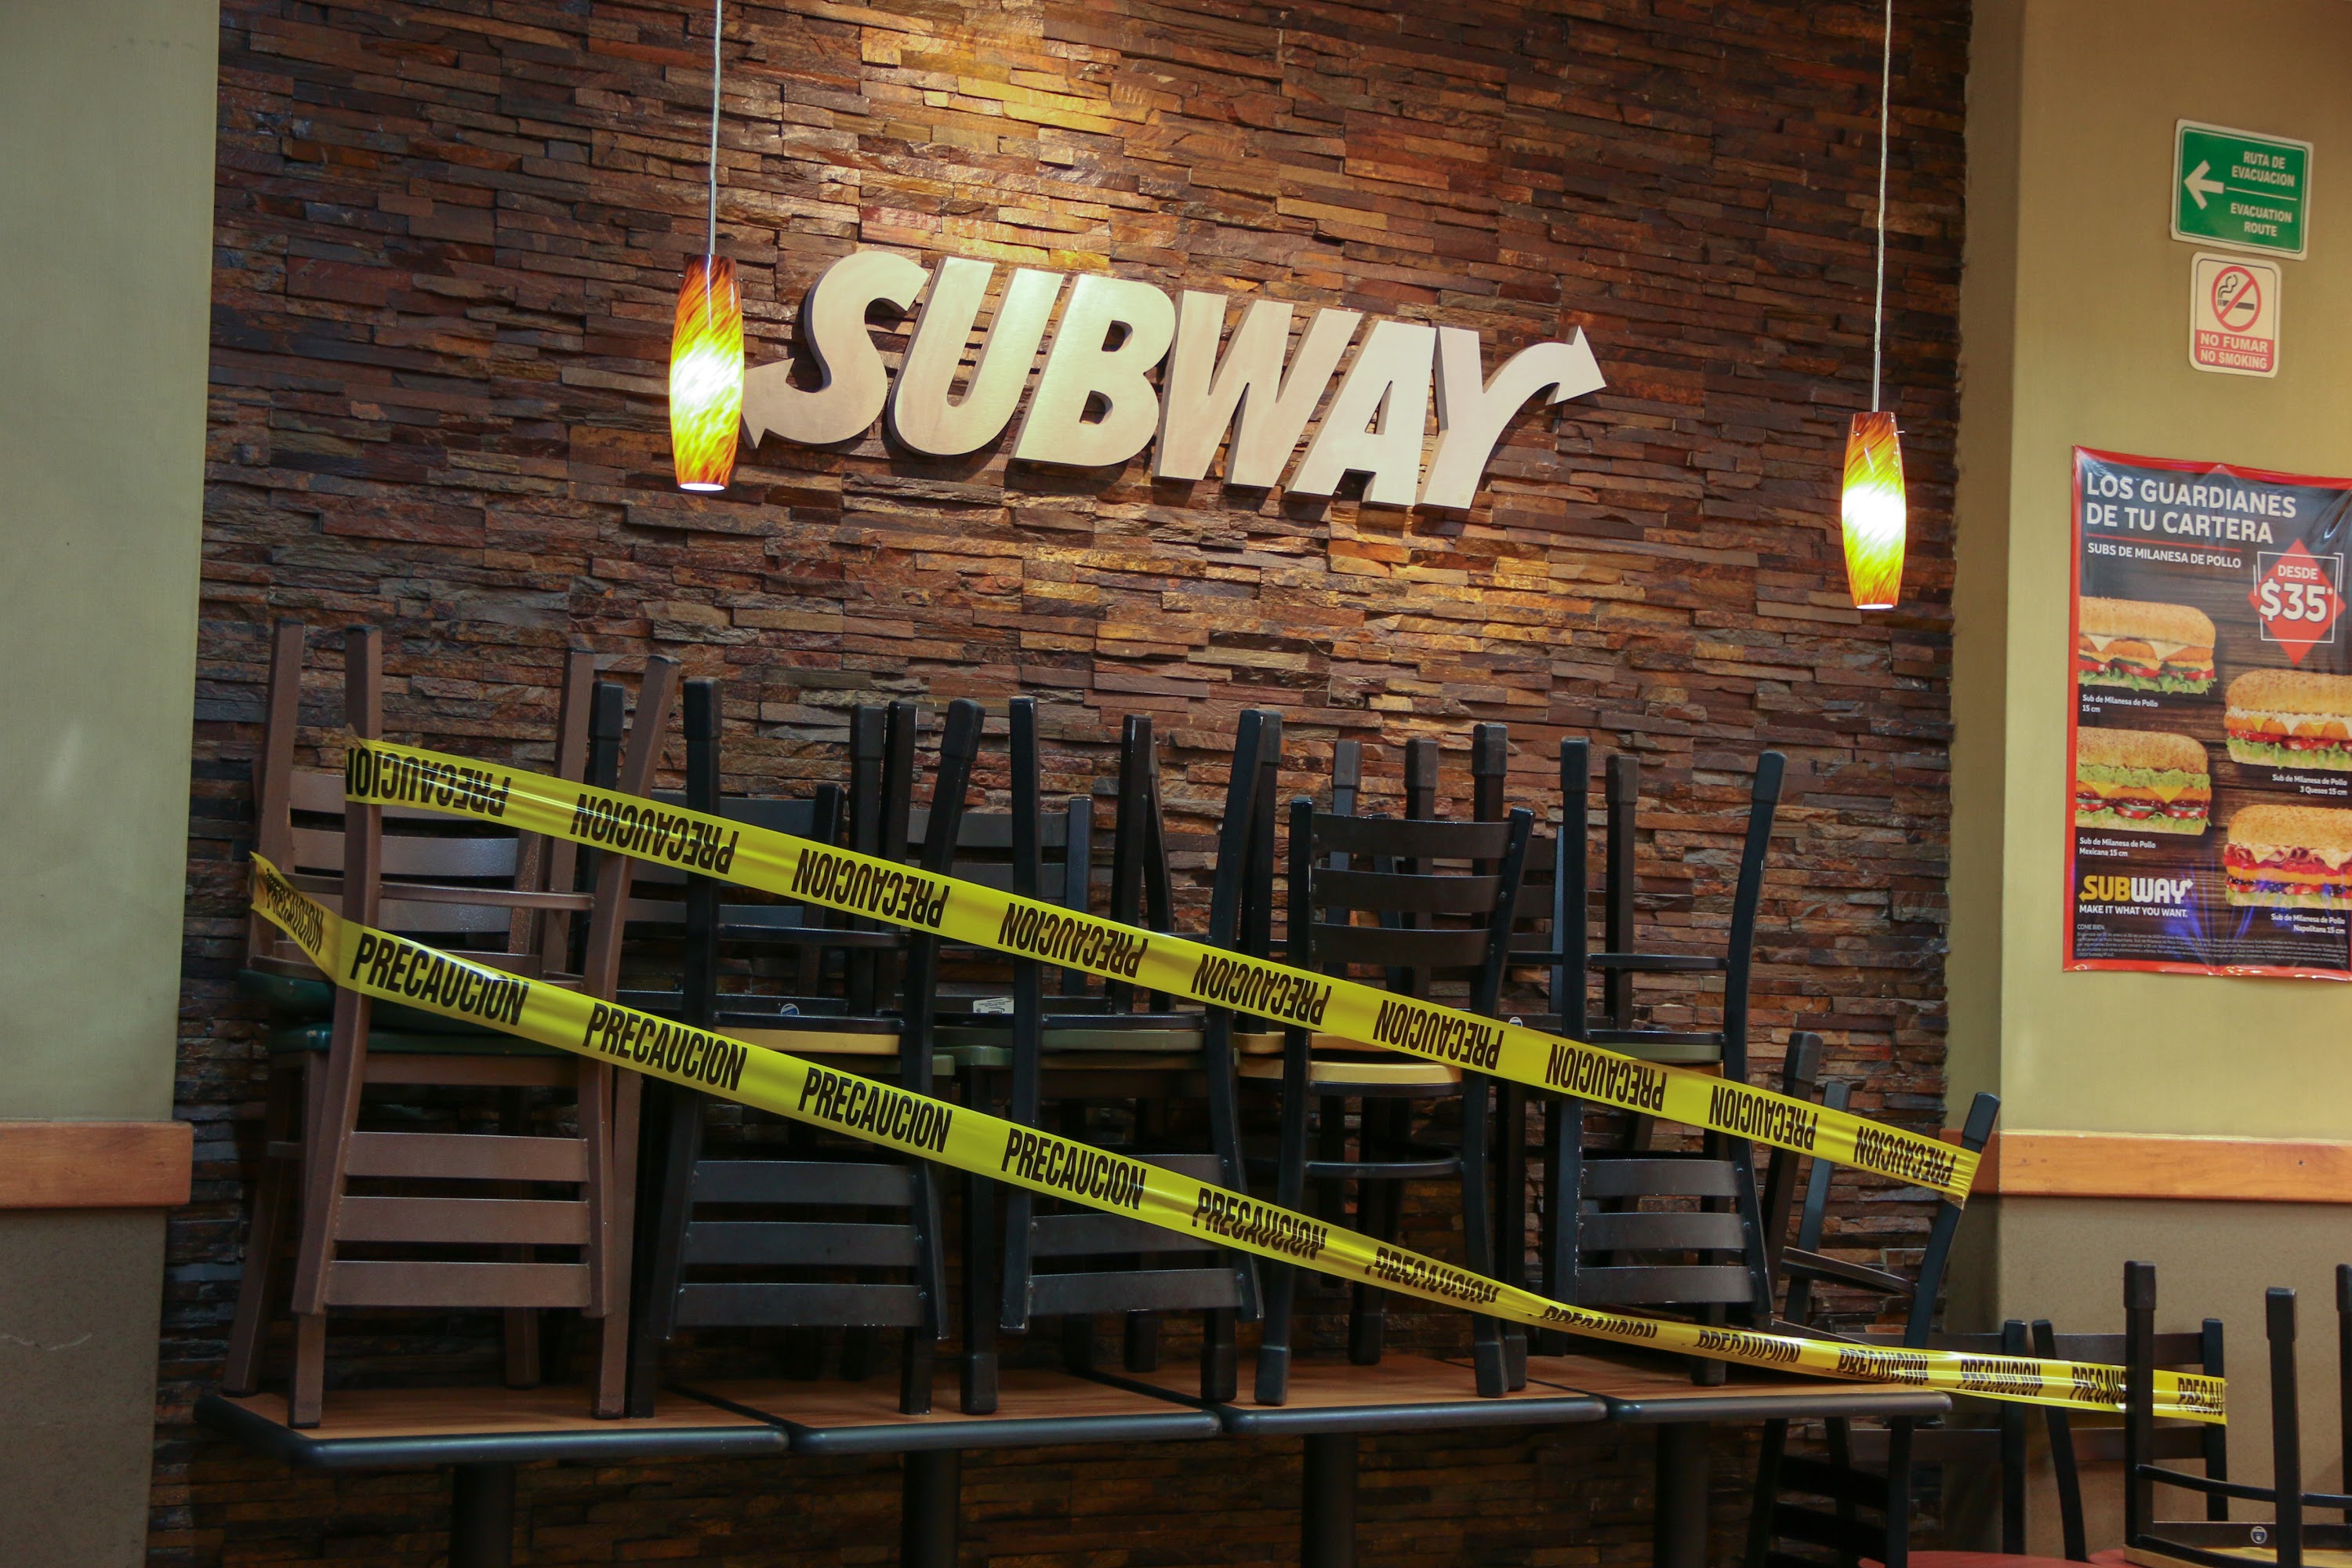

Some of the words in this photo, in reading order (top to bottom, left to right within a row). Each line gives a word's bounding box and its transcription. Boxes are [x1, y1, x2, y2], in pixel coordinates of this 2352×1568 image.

[2243, 151, 2269, 166] RUTA
[2272, 155, 2285, 169] DE
[2232, 165, 2295, 187] EVACUACION
[2230, 203, 2292, 223] EVACUATION
[2245, 221, 2278, 236] ROUTE
[2201, 333, 2219, 347] NO
[2223, 336, 2268, 353] FUMAR
[2201, 349, 2216, 362] NO
[2219, 351, 2267, 369] SMOKING
[741, 252, 1606, 509] SUBWAY
[2087, 472, 2134, 500] LOS
[2140, 480, 2296, 518] GUARDIANES
[2086, 503, 2118, 527] DE
[2124, 507, 2156, 532] TU
[2162, 512, 2274, 544] CARTERA
[2088, 543, 2116, 557] SUBS
[2118, 546, 2132, 558] DE
[2135, 548, 2188, 564] MILANESA
[2190, 554, 2205, 565] DE
[2206, 555, 2241, 568] POLLO
[2278, 564, 2318, 580] DESDE
[2082, 694, 2094, 702] Sub
[2104, 696, 2131, 706] Milanesa
[2142, 699, 2158, 707] Pollo
[2272, 774, 2283, 782] Sub
[2294, 775, 2321, 785] Milanesa
[2305, 786, 2327, 795] Quesos
[2079, 848, 2107, 856] Mexicana
[2102, 839, 2129, 848] Milanesa
[2079, 875, 2194, 904] SUBWAY
[2079, 905, 2104, 914] MAKE
[2106, 906, 2113, 914] IT
[2114, 906, 2140, 916] WHAT
[2142, 908, 2159, 916] YOU
[2161, 909, 2188, 918] WANT.
[2270, 913, 2282, 921] Sub
[2293, 924, 2325, 934] Napolitana
[570, 794, 739, 875] PRECAUCION
[791, 848, 950, 928] PRECAUCION
[997, 902, 1149, 978] PRECAUCION
[1191, 953, 1332, 1025] PRECAUCION
[1373, 1000, 1504, 1070] PRECAUCION
[1545, 1044, 1668, 1112] PRECAUCION
[1709, 1085, 1818, 1150] PRECAUCION
[1853, 1126, 1956, 1187] PRECAUCION
[350, 935, 529, 1026] PRECAUCION
[583, 1004, 747, 1091] PRECAUCION
[797, 1067, 953, 1152] PRECAUCION
[1001, 1128, 1146, 1210] PRECAUCION
[1192, 1188, 1327, 1261] PRECAUCION
[1365, 1247, 1501, 1305] PRECAUCION
[2176, 1377, 2223, 1417] PRECAU
